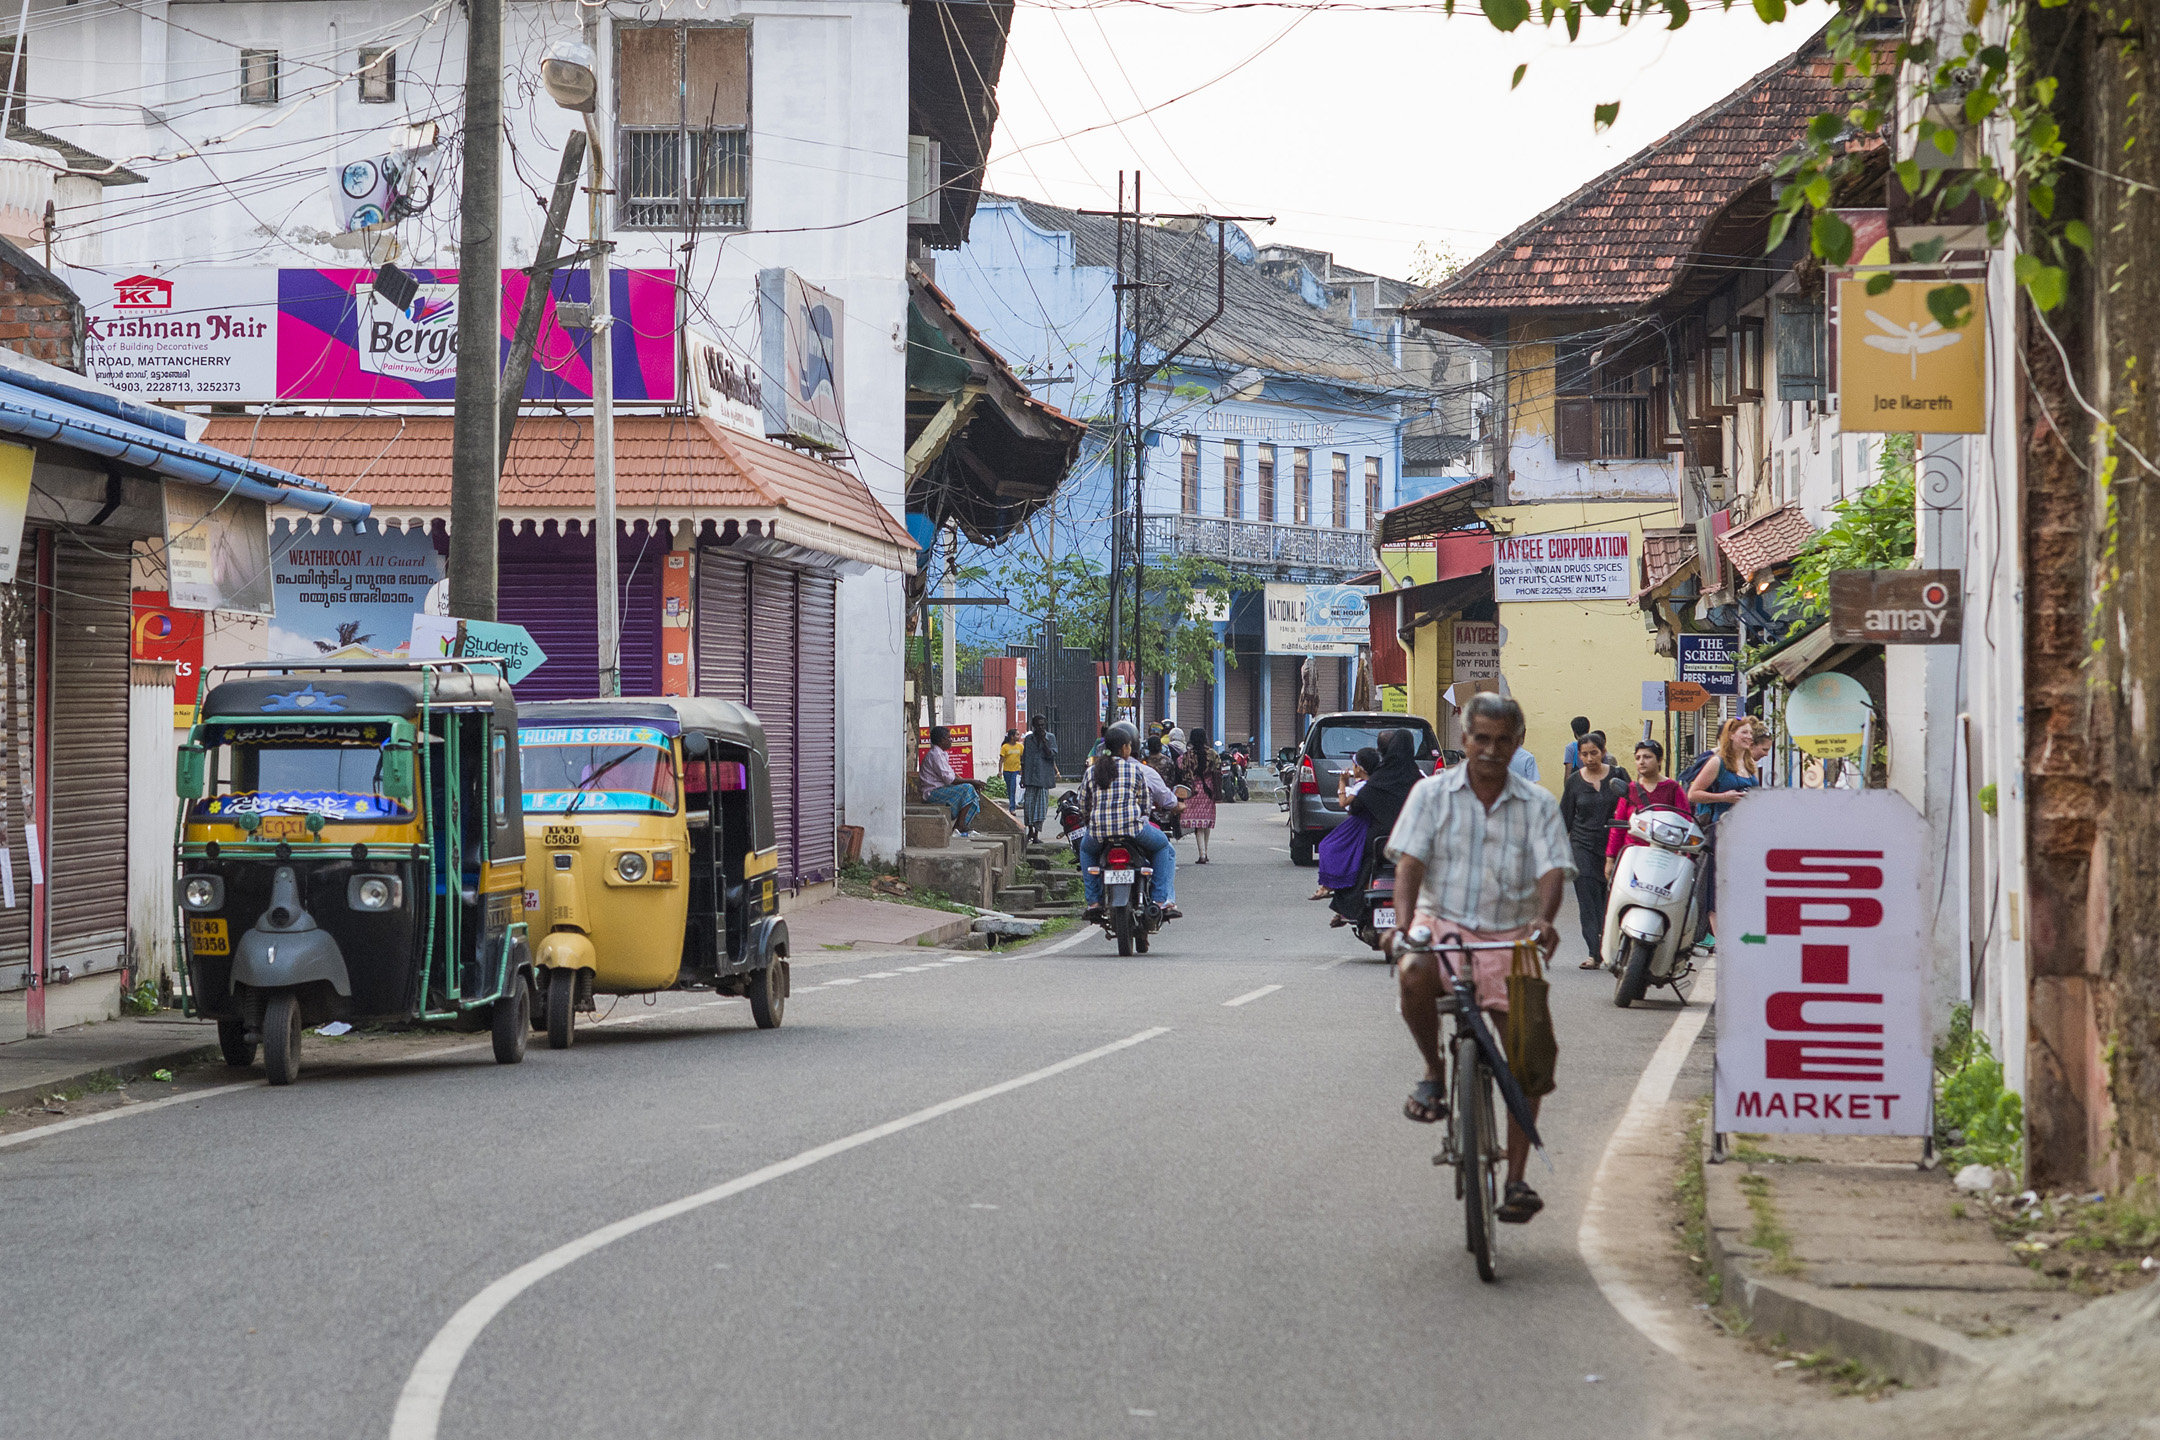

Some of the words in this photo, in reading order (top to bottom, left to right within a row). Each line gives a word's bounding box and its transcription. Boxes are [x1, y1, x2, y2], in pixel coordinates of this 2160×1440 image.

[207, 315, 268, 341] Nair
[107, 342, 117, 351] of
[120, 342, 153, 352] Building
[157, 342, 208, 351] Decoratives
[98, 357, 134, 367] ROAD,
[138, 357, 231, 366] MATTANCHERRY
[383, 363, 404, 371] Paint
[405, 365, 423, 374] your
[146, 383, 193, 393] 2228713,
[197, 383, 241, 391] 3252373
[1874, 394, 1897, 411] Joe
[1901, 395, 1953, 410] Ikareth
[1498, 539, 1544, 561] KAYCEE
[1548, 536, 1628, 560] CORPORATION
[289, 550, 362, 566] WEATHERCOAT
[365, 556, 385, 567] All
[388, 556, 425, 567] Guard
[1500, 566, 1523, 575] Dealers
[1525, 566, 1532, 574] in
[1535, 565, 1561, 574] INDIAN
[1500, 577, 1515, 585] DRY
[1549, 574, 1582, 583] CASHEW
[1585, 574, 1606, 583] NUTS
[1268, 600, 1298, 622] NATIONAL
[1864, 609, 1947, 638] amay
[465, 636, 528, 657] Student's
[1698, 638, 1723, 649] THE
[1456, 649, 1480, 657] Dealers
[1683, 673, 1706, 684] PRESS
[524, 730, 567, 743] ALLAH
[570, 730, 583, 742] IS
[587, 728, 633, 742] GREAT
[545, 835, 580, 844] C5638
[1765, 848, 1883, 1082] SPICE
[1736, 1091, 1900, 1120] MARKET
